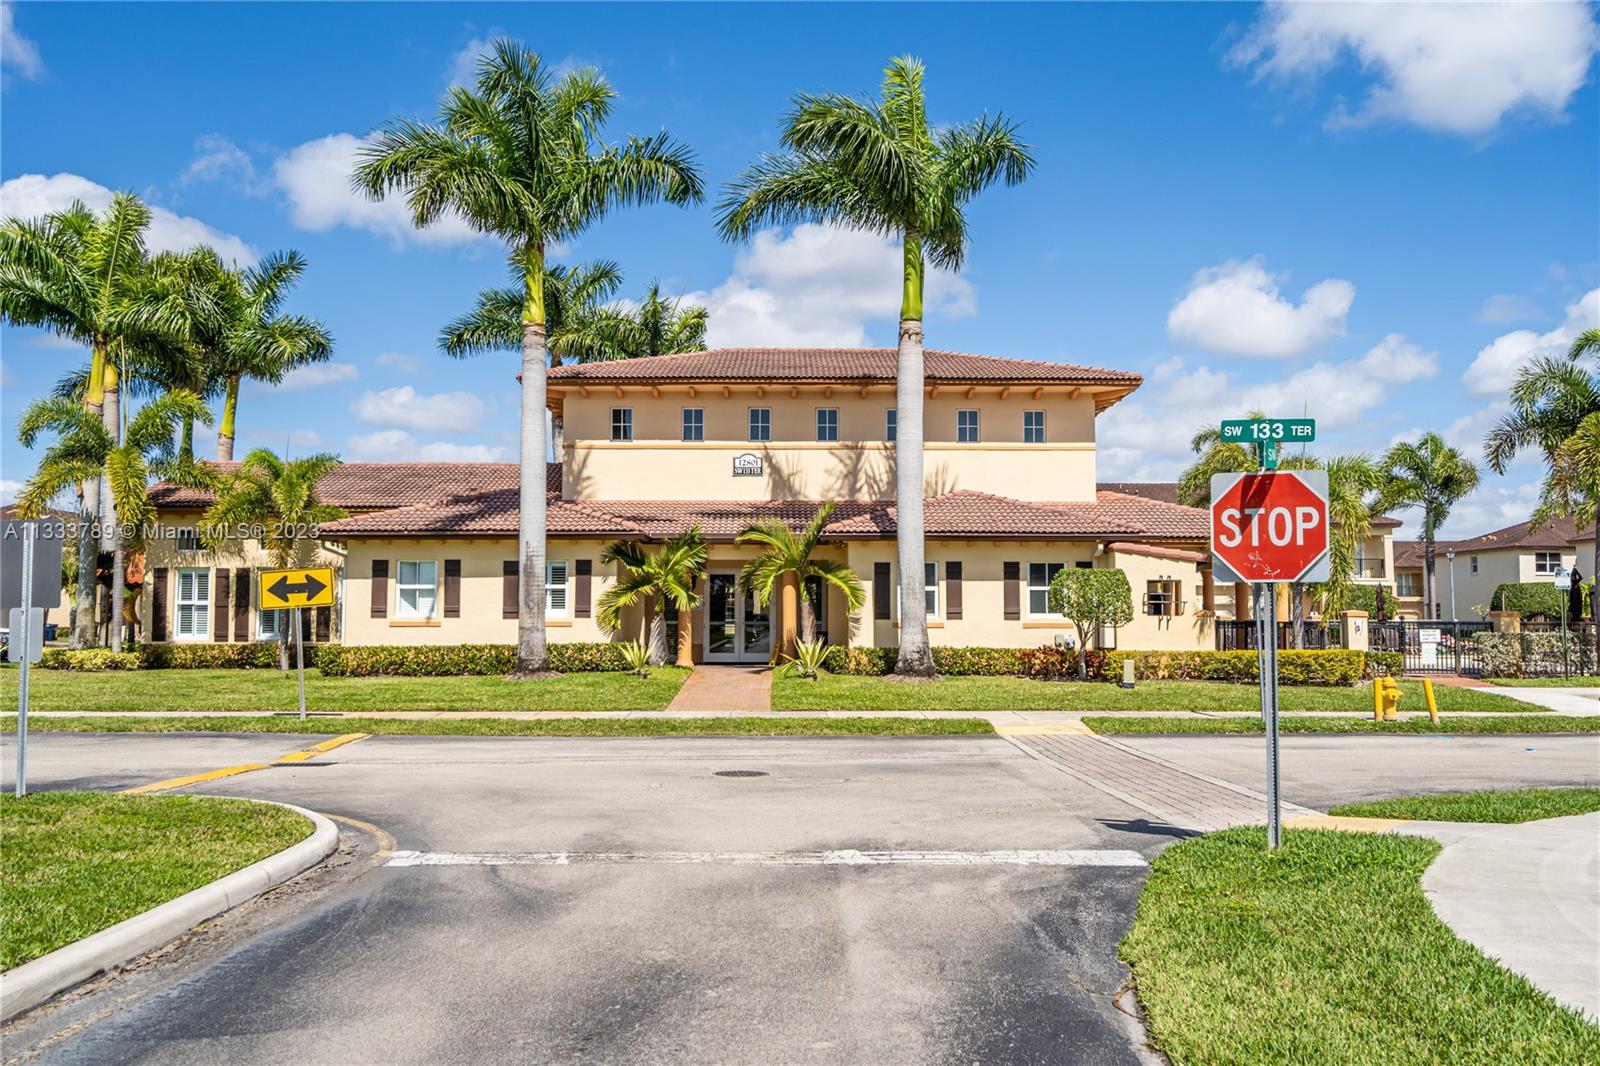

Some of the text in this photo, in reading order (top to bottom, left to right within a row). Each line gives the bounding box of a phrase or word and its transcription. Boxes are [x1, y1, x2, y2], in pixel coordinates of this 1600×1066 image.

[1224, 423, 1312, 439] SW 133 TER
[1220, 507, 1320, 548] STOP
